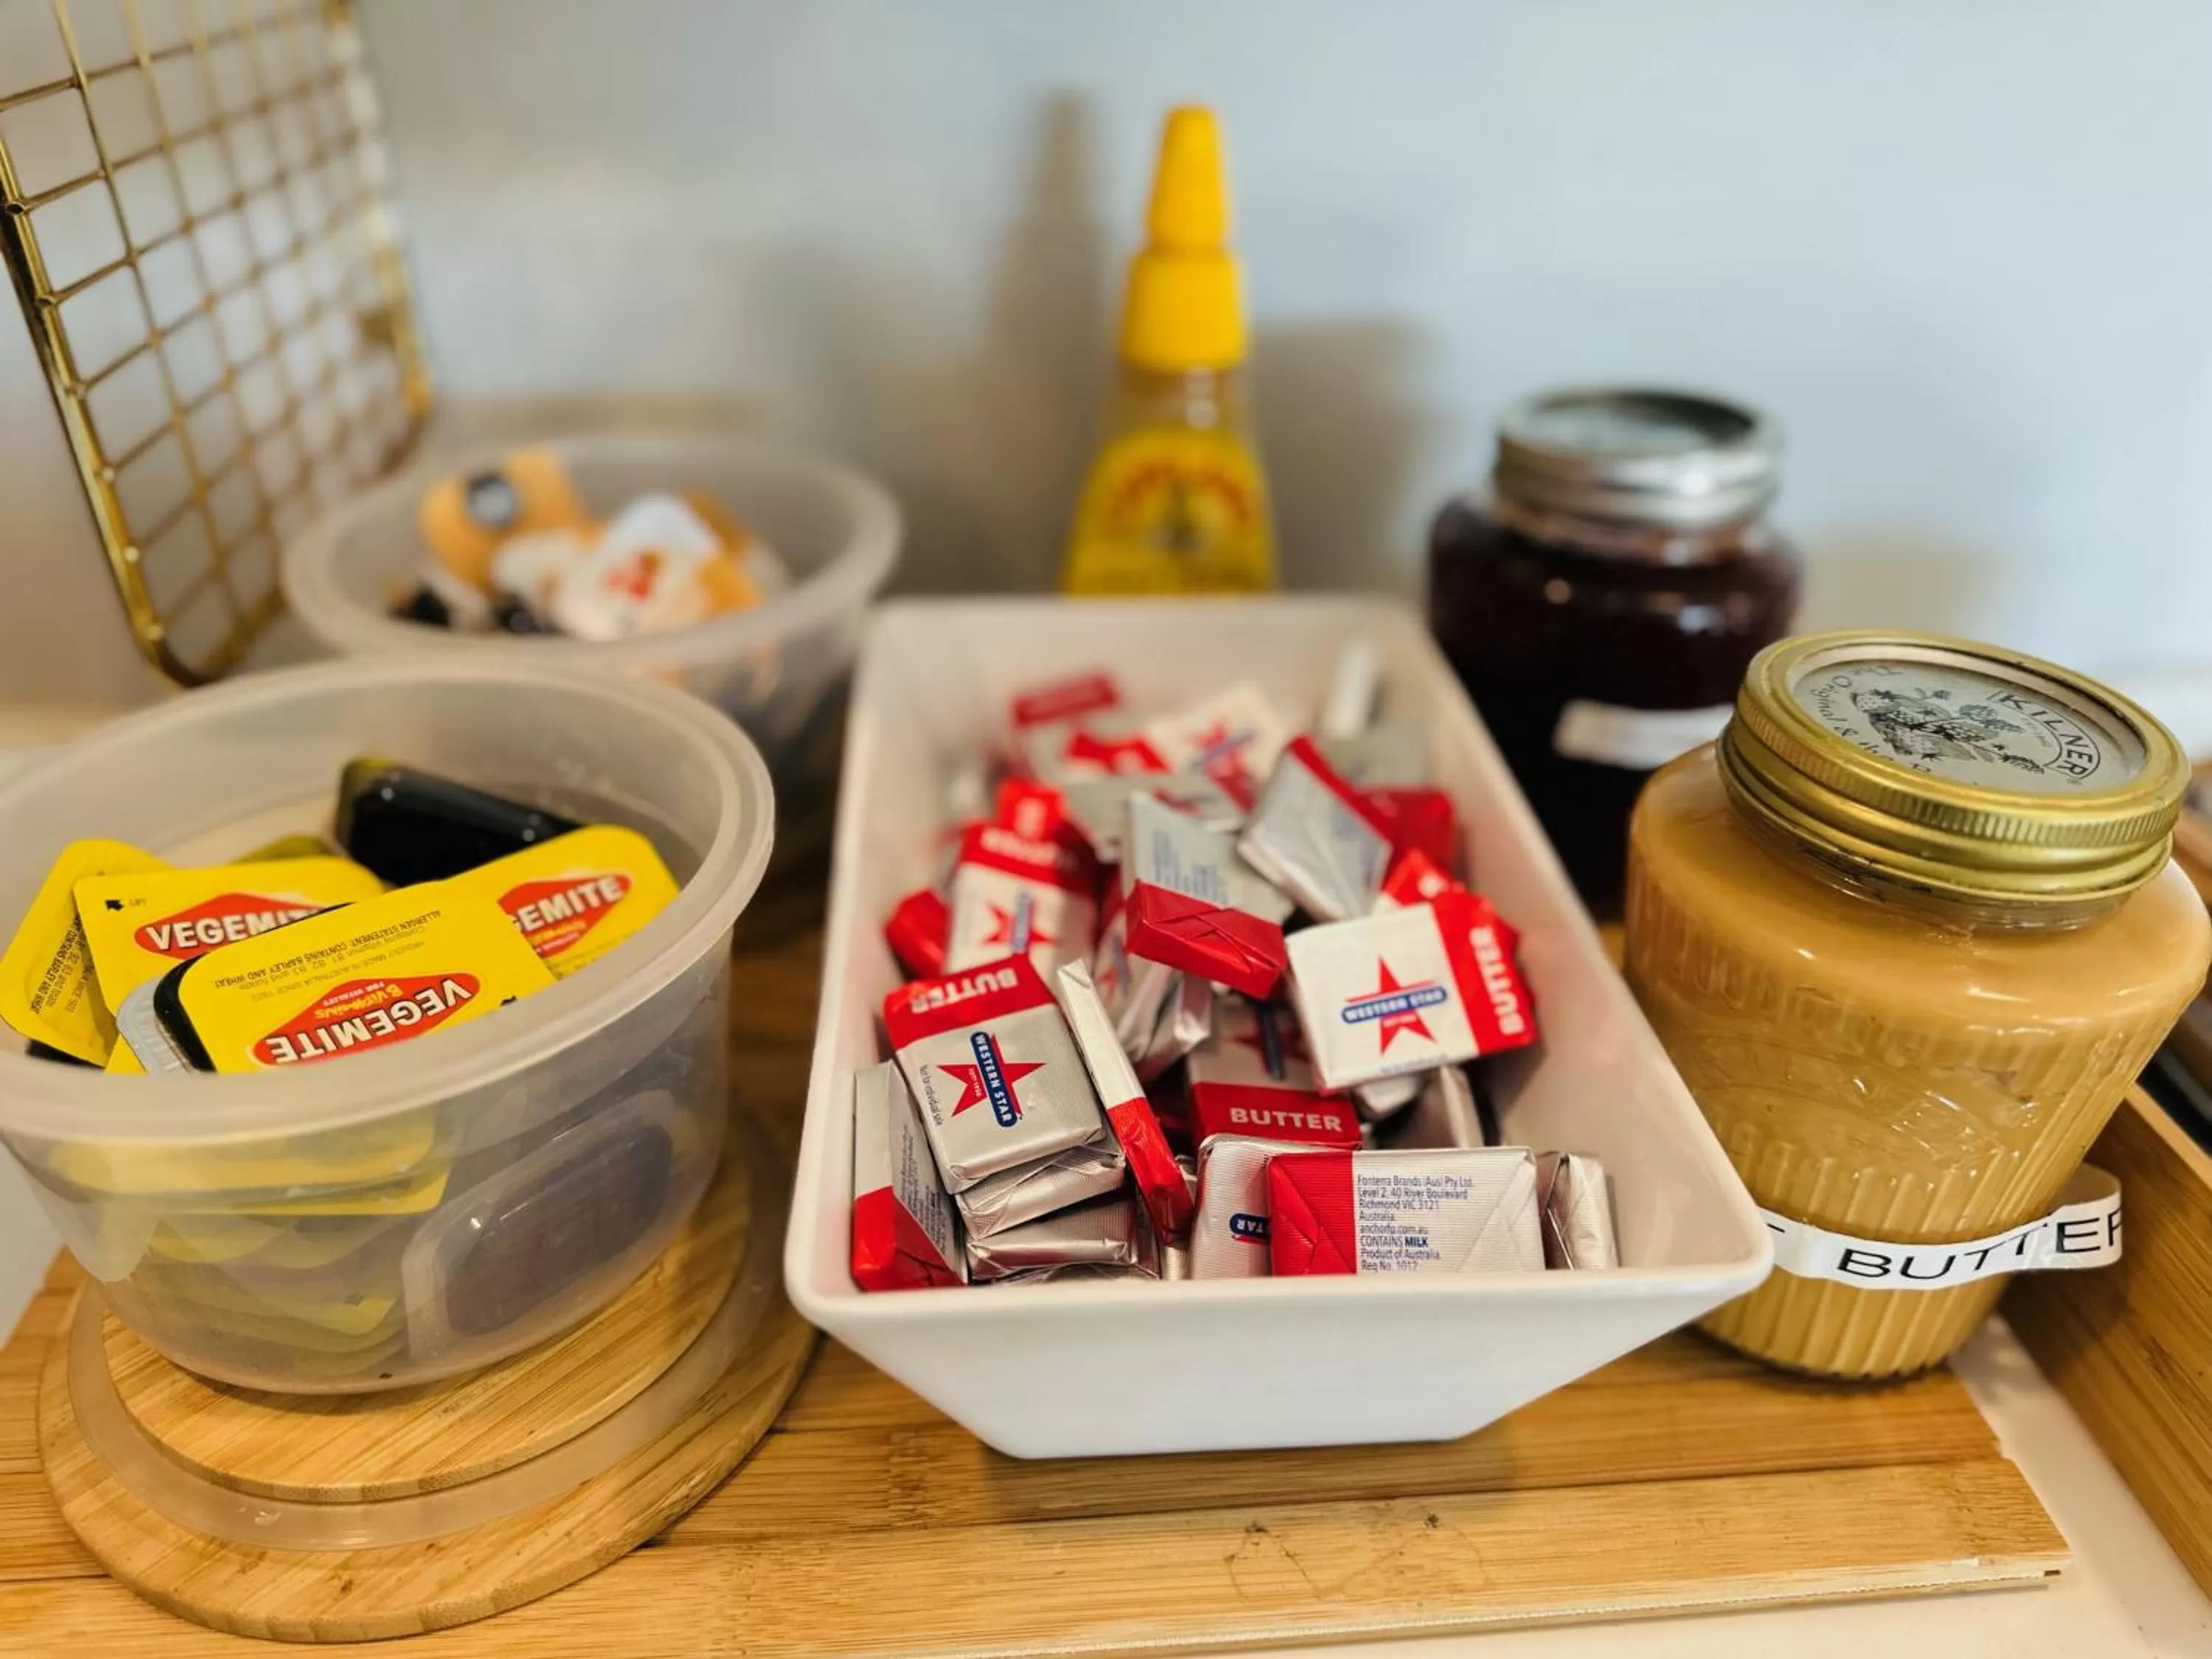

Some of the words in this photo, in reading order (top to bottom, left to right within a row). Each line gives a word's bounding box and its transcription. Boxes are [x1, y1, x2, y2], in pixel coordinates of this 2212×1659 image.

[1810, 675, 1852, 722] Original
[1999, 695, 2093, 775] KILNER
[514, 874, 623, 931] EMITE
[145, 908, 321, 950] VEGEMI
[399, 911, 441, 931] ALLERGEN
[303, 942, 347, 961] CONTAINS
[247, 967, 267, 980] AND
[269, 956, 303, 973] BARLEY
[1468, 925, 1526, 1035] BUTTER
[911, 967, 1018, 1014] BUTTER
[265, 978, 473, 1064] VEGEMITE
[975, 1034, 1001, 1089] WESTERN
[994, 1090, 1013, 1122] STAR
[1228, 1107, 1343, 1133] BUTTER
[1357, 1174, 1391, 1186] Fonterra
[1393, 1175, 1422, 1186] Brands
[1444, 1175, 1458, 1190] Pty
[1358, 1186, 1379, 1198] Level
[1391, 1186, 1402, 1198] 40
[1403, 1187, 1425, 1199] River
[1426, 1188, 1468, 1200] Boulevard
[1359, 1198, 1400, 1209] Richmond
[1402, 1200, 1417, 1210] VIC
[1418, 1200, 1439, 1210] 3121
[1359, 1210, 1395, 1221] Australia
[1237, 1219, 1270, 1235] TAR
[1360, 1235, 1403, 1246] CONTAINS
[1405, 1236, 1428, 1248] MILK
[1361, 1248, 1393, 1259] Product
[1394, 1248, 1402, 1259] of
[1361, 1259, 1378, 1272] Reg
